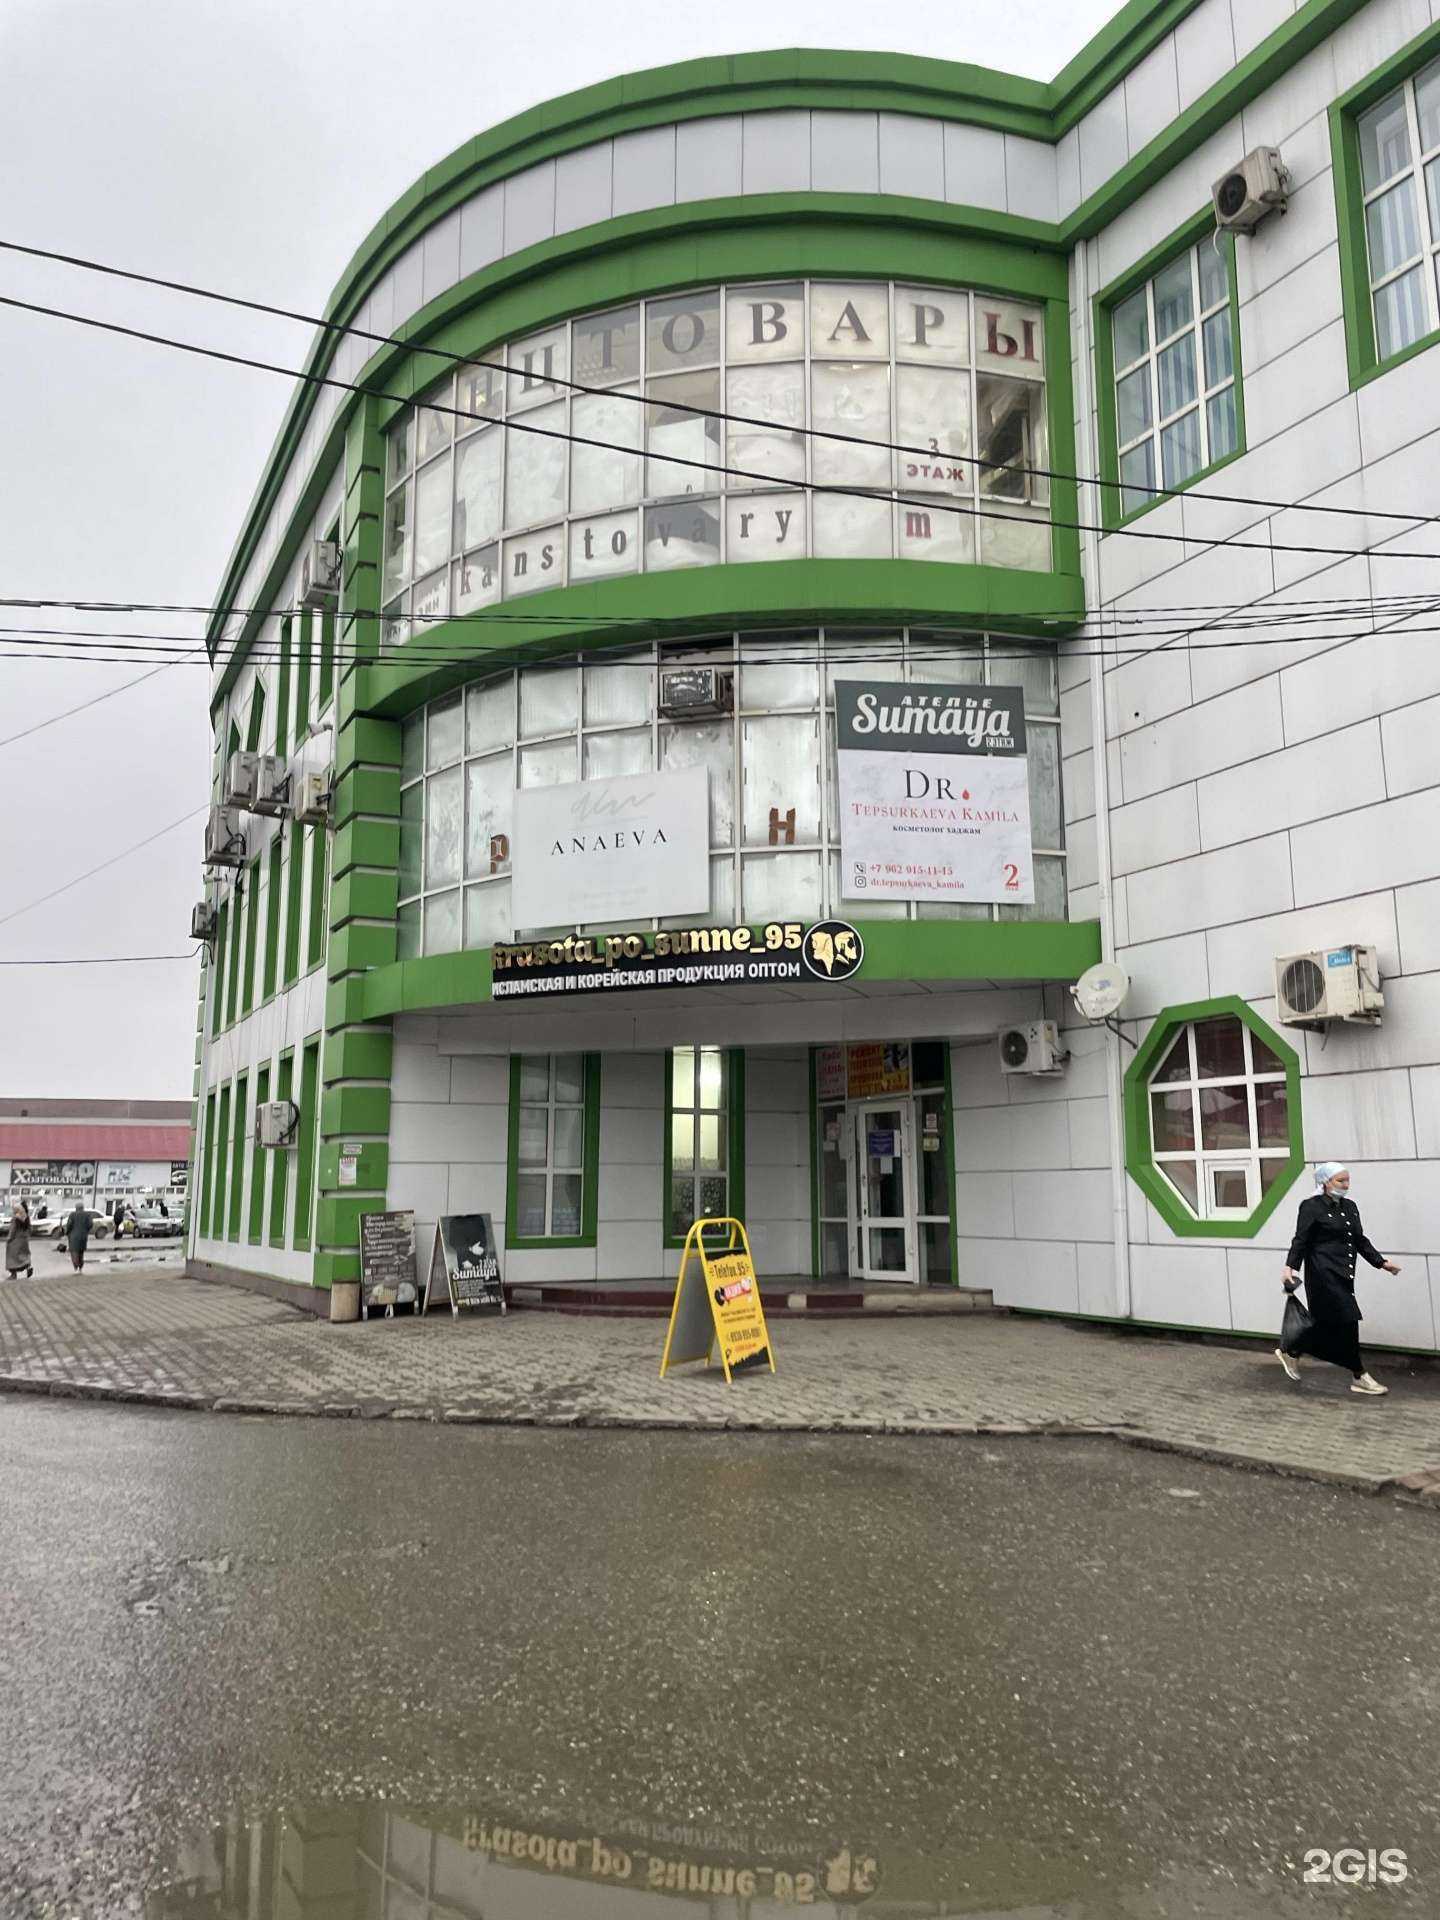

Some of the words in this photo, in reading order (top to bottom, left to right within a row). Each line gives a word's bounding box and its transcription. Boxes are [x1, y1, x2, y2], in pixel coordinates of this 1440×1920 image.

[906, 464, 964, 481] ЭТАЖ
[901, 695, 993, 709] АТЕЛЬЕ
[852, 694, 1011, 748] Sumaya
[551, 828, 667, 856] ANAEVA
[870, 865, 881, 873] +7
[1003, 864, 1019, 887] 2
[565, 975, 577, 989] И
[578, 968, 654, 989] КОРЕЙСКАЯ
[658, 963, 745, 984] ПРОДУКЦИЯ
[749, 962, 800, 977] ОПТОМ
